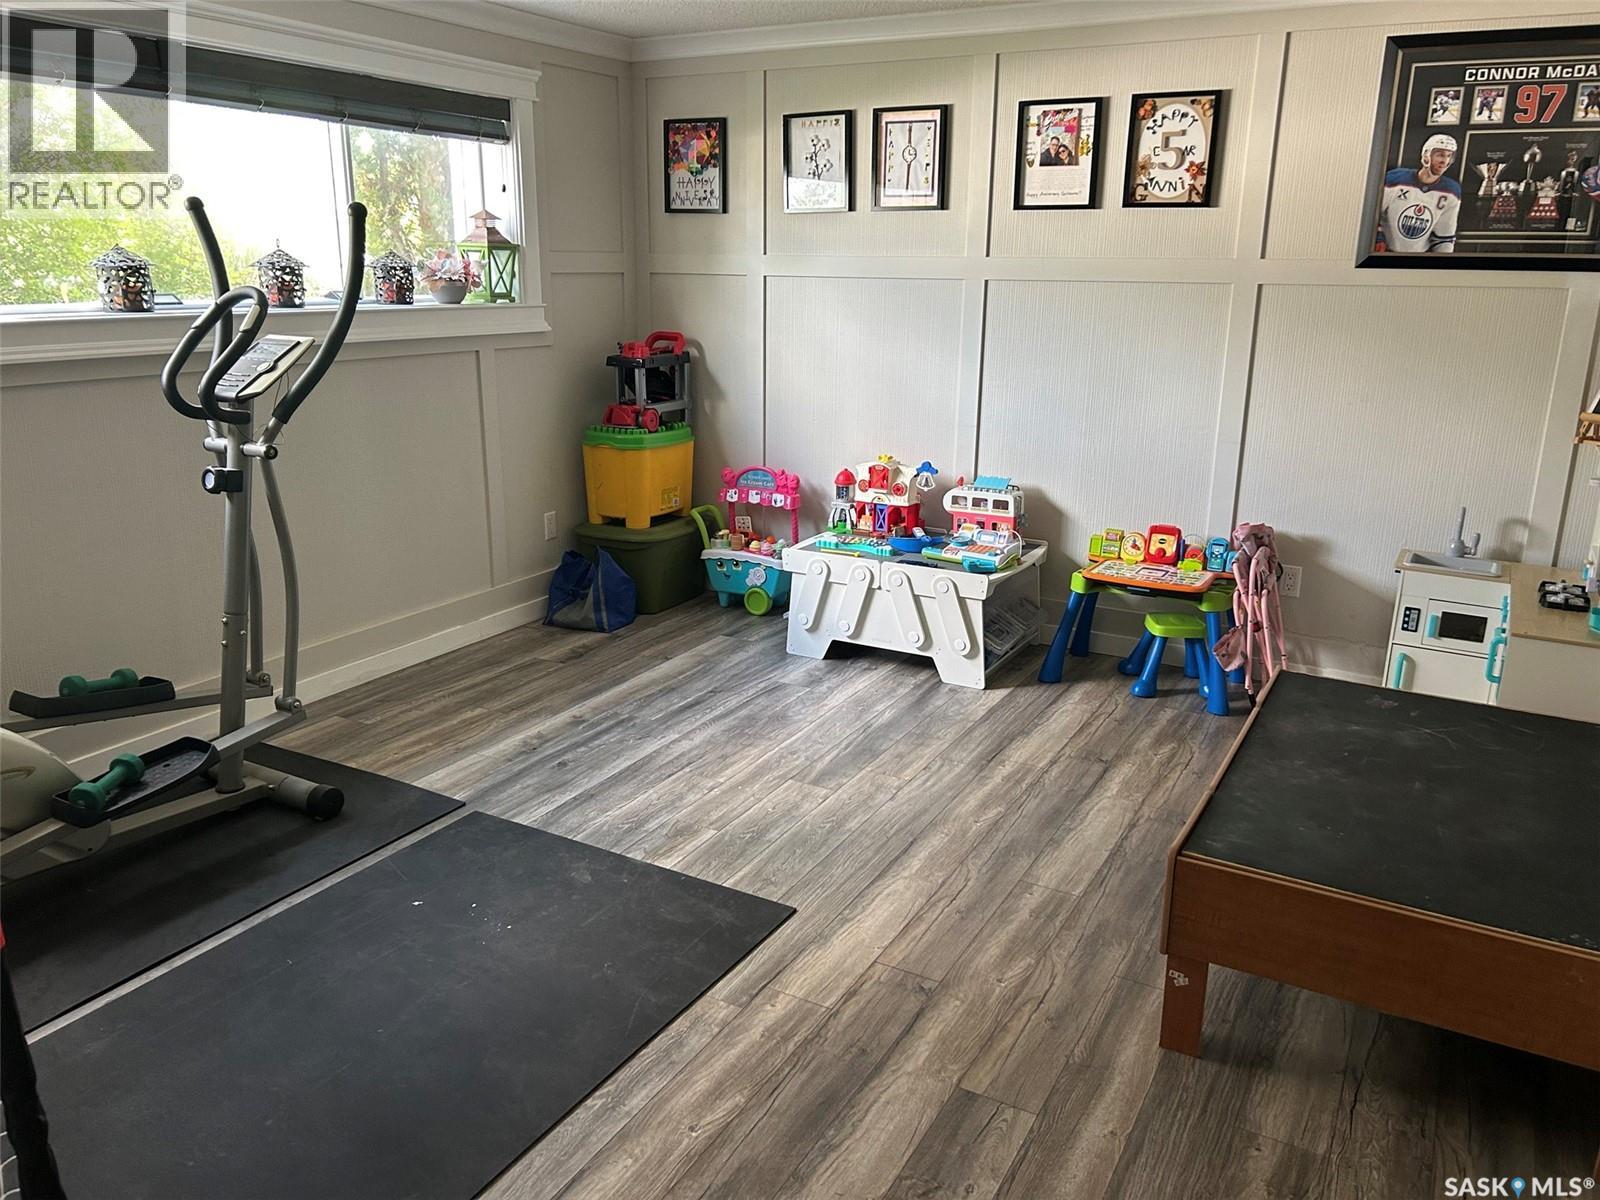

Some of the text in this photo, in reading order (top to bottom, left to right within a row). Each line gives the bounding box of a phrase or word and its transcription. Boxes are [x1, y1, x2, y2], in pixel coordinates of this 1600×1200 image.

[1465, 64, 1600, 81] CONNOR McDA
[1514, 84, 1568, 123] 97
[1158, 129, 1187, 170] 5
[677, 176, 715, 189] HAPPY
